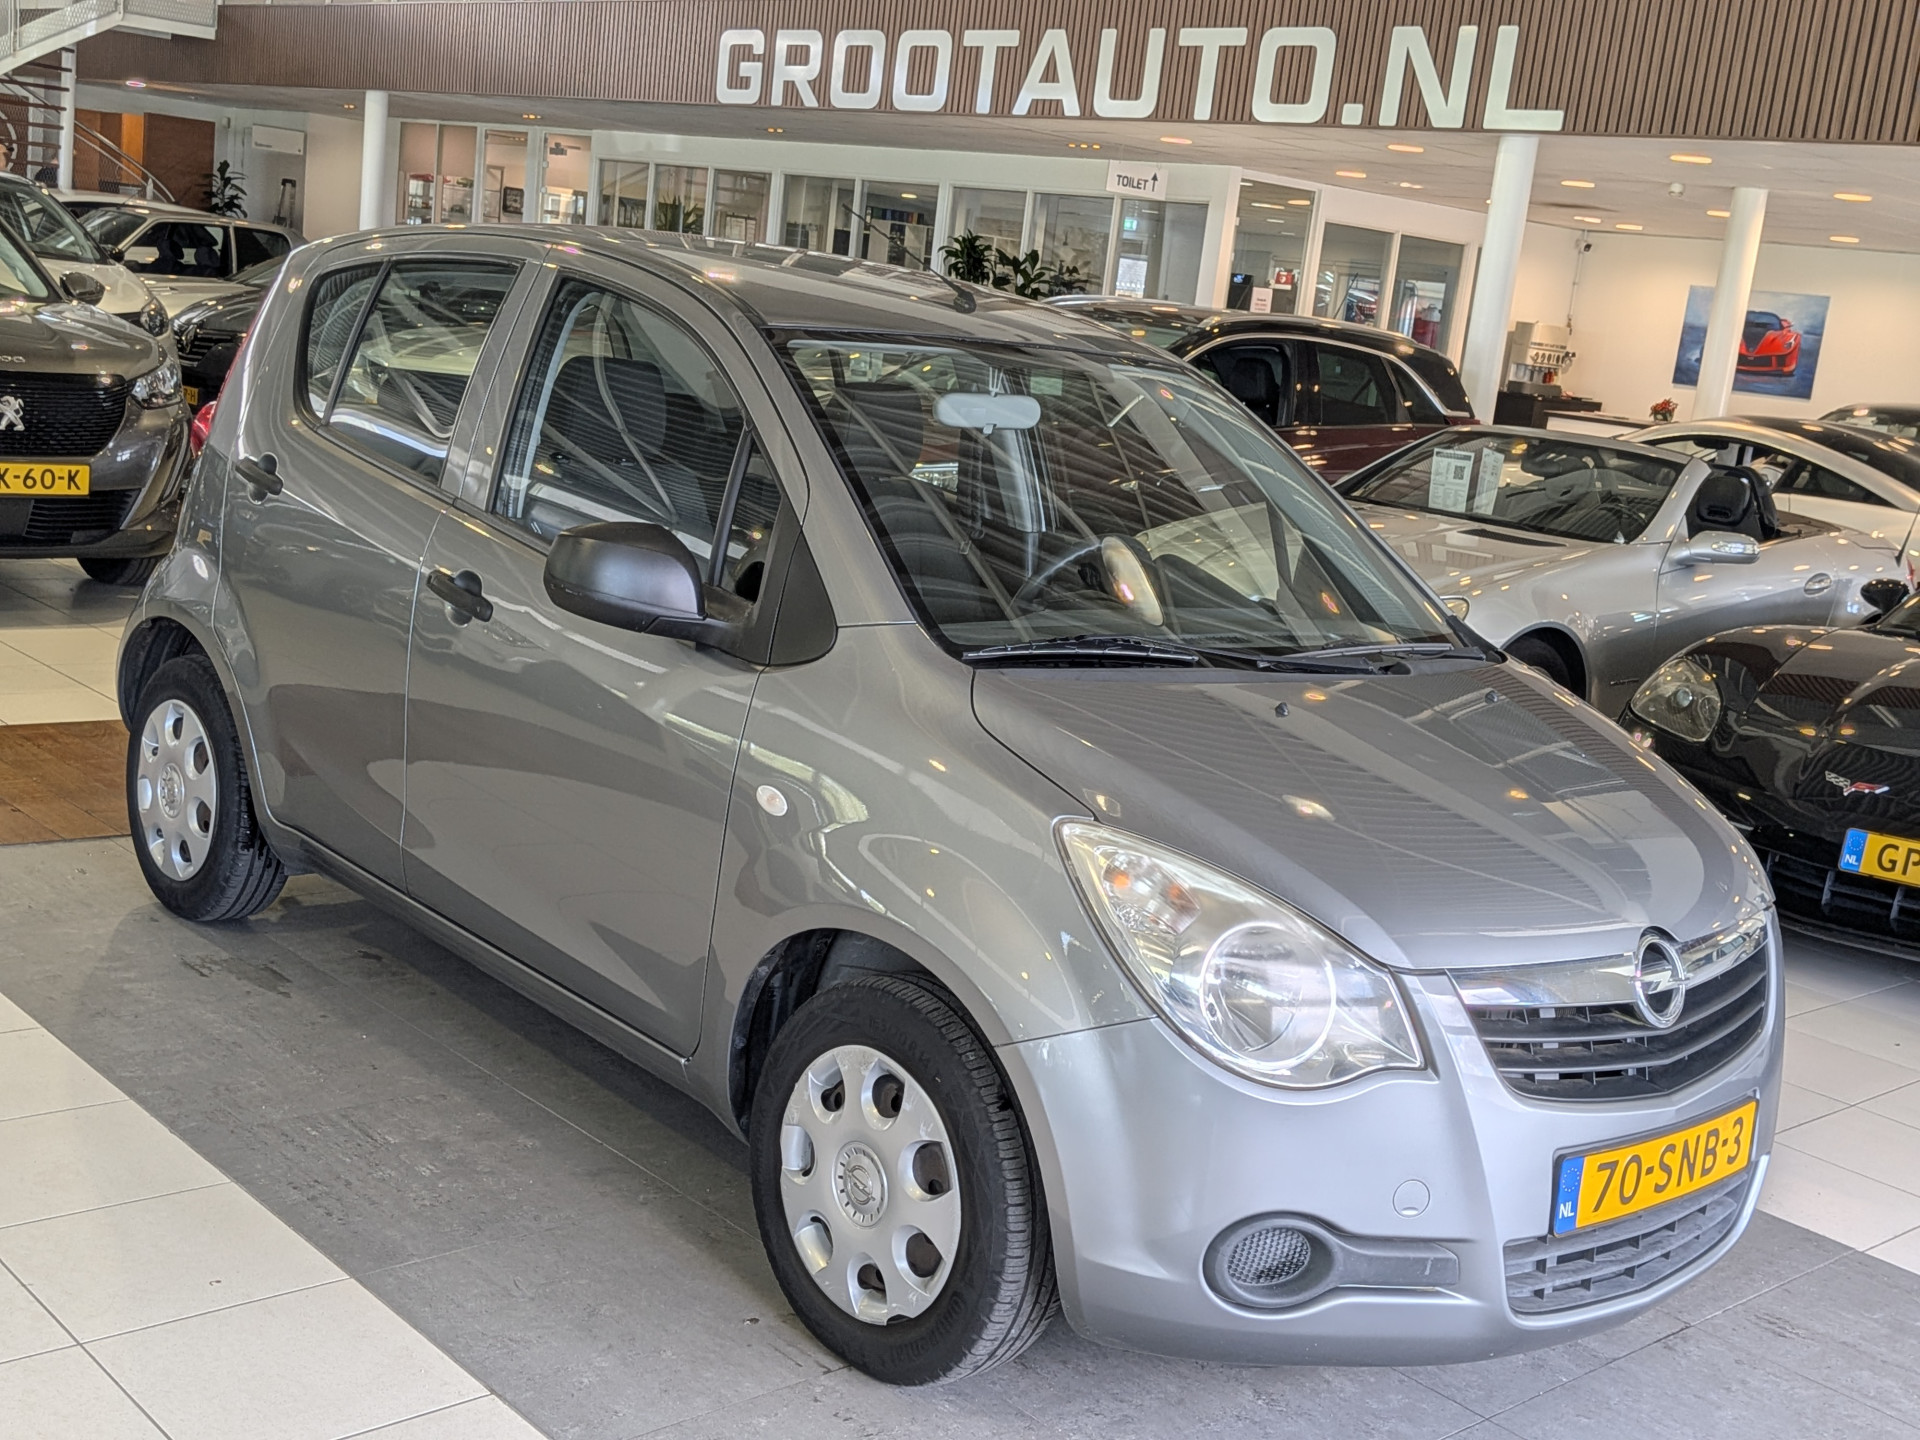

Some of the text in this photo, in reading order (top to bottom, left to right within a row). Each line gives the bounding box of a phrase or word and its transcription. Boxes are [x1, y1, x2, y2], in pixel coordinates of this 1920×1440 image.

[716, 24, 1564, 131] GROOTAUTO.NL
[1116, 174, 1149, 190] TOILET
[1844, 854, 1859, 865] NL
[1558, 1116, 1744, 1219] NL 70-SNB-3
